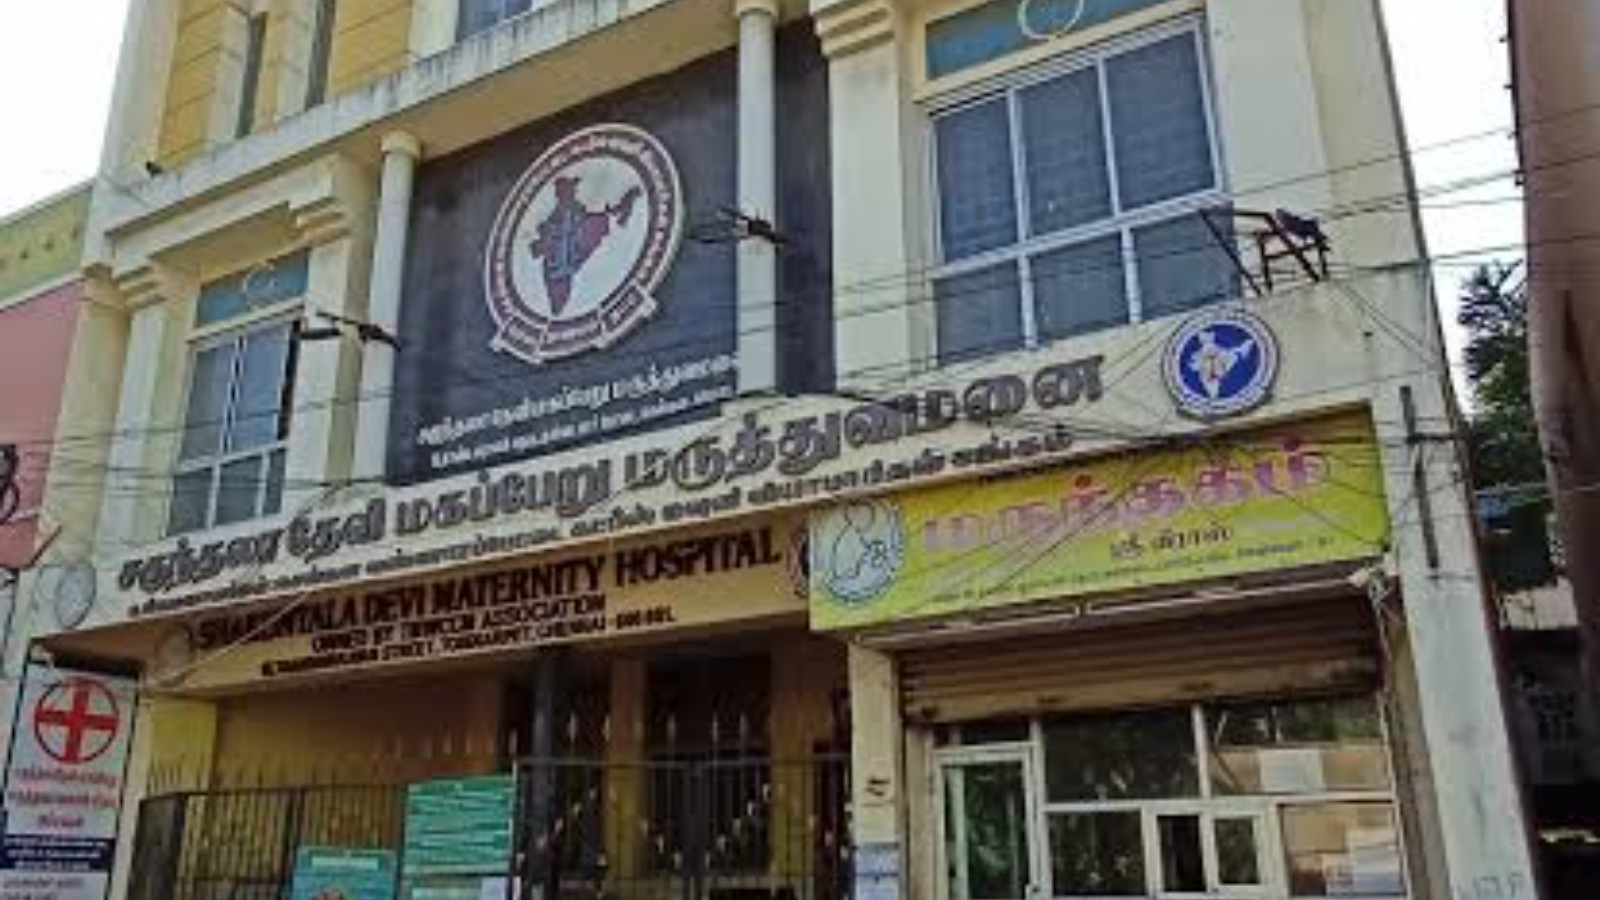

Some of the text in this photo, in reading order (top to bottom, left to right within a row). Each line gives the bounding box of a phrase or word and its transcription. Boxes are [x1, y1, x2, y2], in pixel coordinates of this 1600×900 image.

[287, 497, 386, 562] தேவி
[397, 456, 611, 534] மகப்பேறு
[624, 355, 1103, 490] மருத்துவமனை
[363, 585, 428, 626] DEVI
[431, 557, 606, 621] MATERNITY
[615, 529, 780, 587] HOSPITAL
[373, 625, 394, 645] BY
[479, 596, 606, 628] ASSOCIATION
